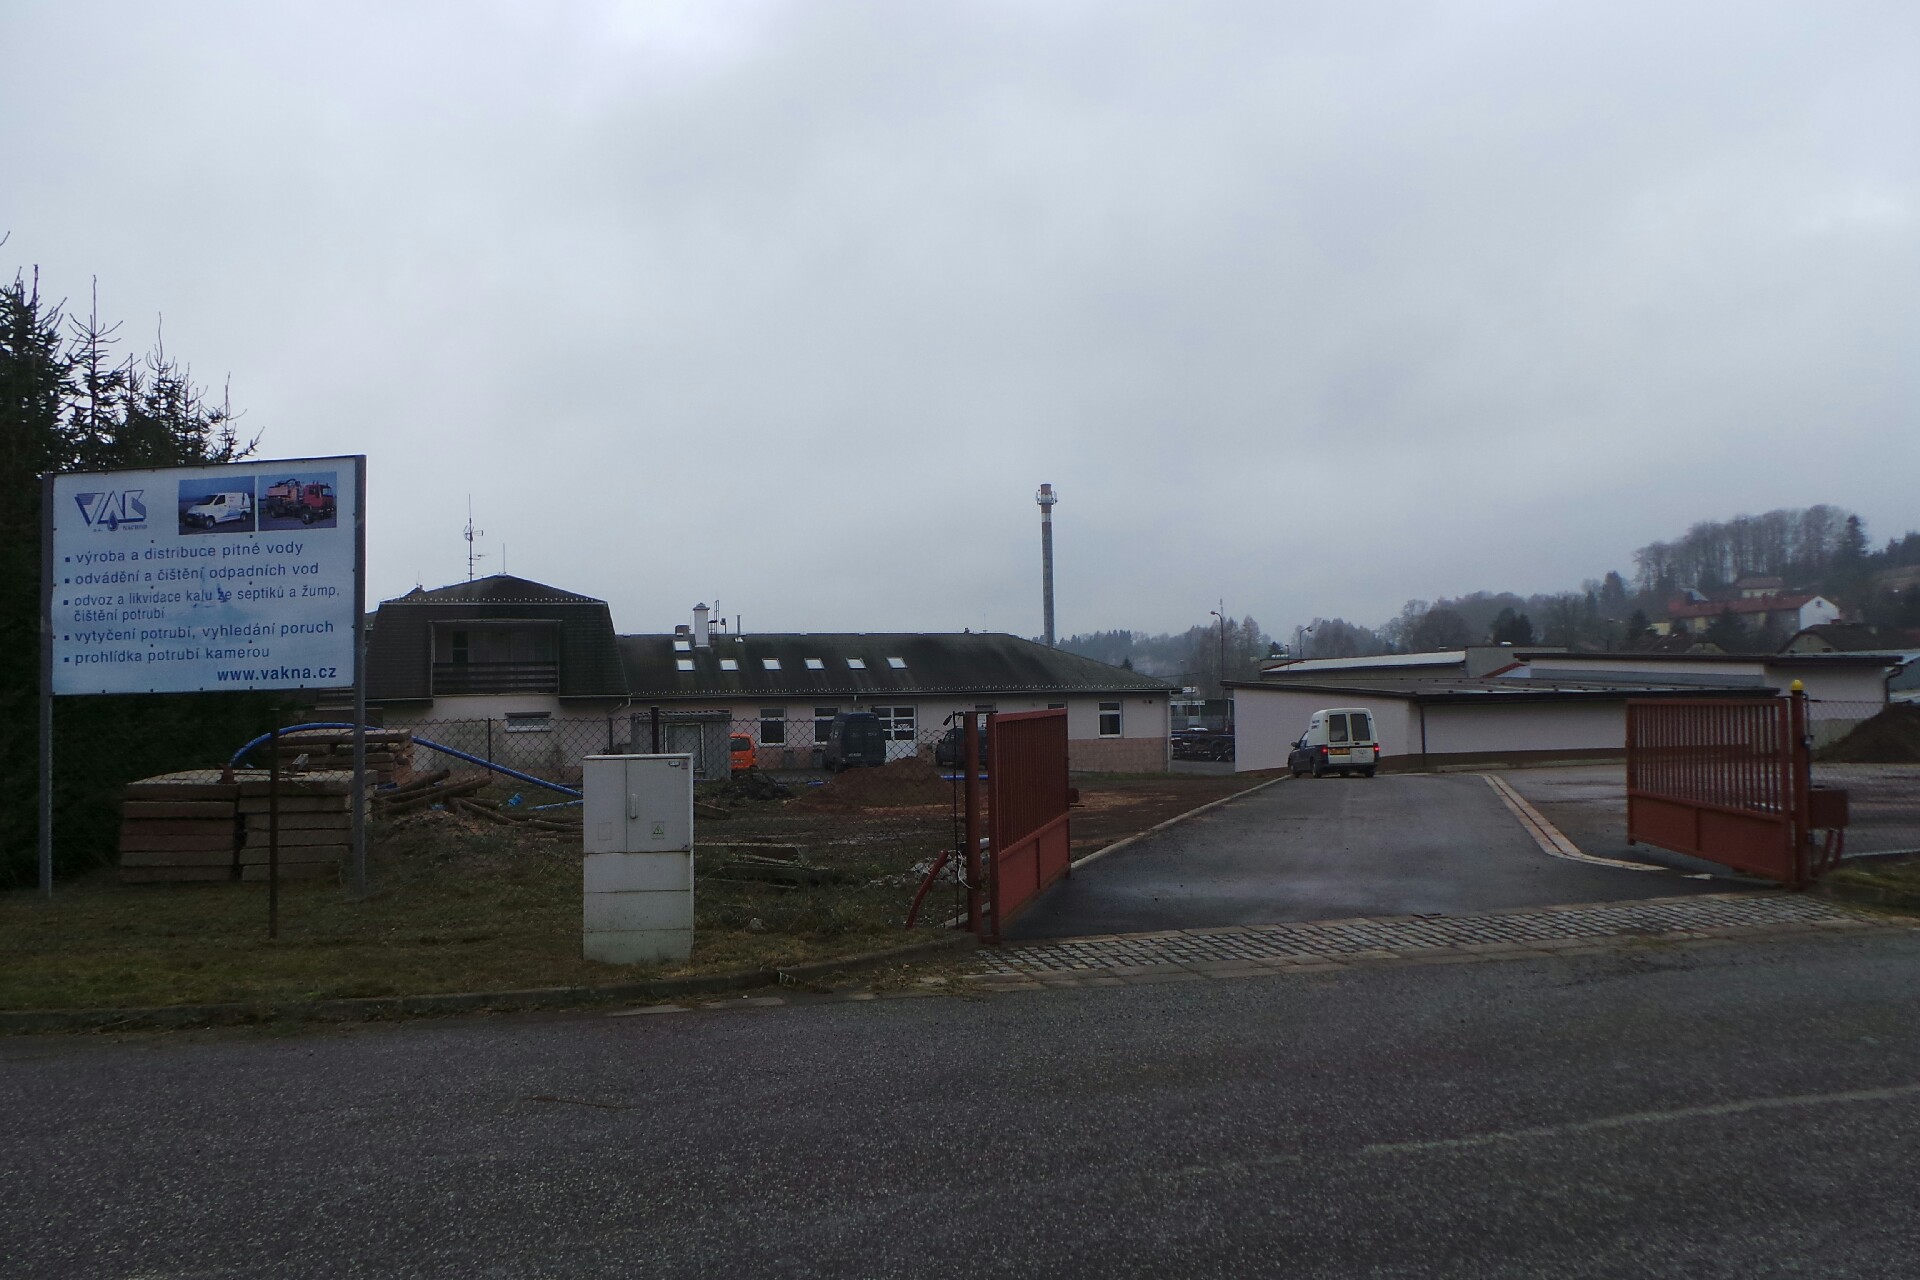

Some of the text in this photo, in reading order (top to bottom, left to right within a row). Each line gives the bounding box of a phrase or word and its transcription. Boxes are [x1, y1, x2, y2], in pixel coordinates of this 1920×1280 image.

[76, 541, 304, 566] výroba a distribuce pitné vody
[75, 562, 319, 585] odvádění a čištění odpadních vod
[74, 594, 113, 606] odvoz
[117, 595, 124, 605] a
[129, 591, 181, 604] likvidace
[186, 589, 213, 602] kalu
[289, 588, 296, 598] a
[74, 606, 166, 623] čištění potrubí
[74, 621, 334, 645] vytyčení potrubí, vyhledání poruch
[75, 647, 270, 667] prohlídka potrubí kamerou
[217, 665, 337, 681] www.vakna.cz
